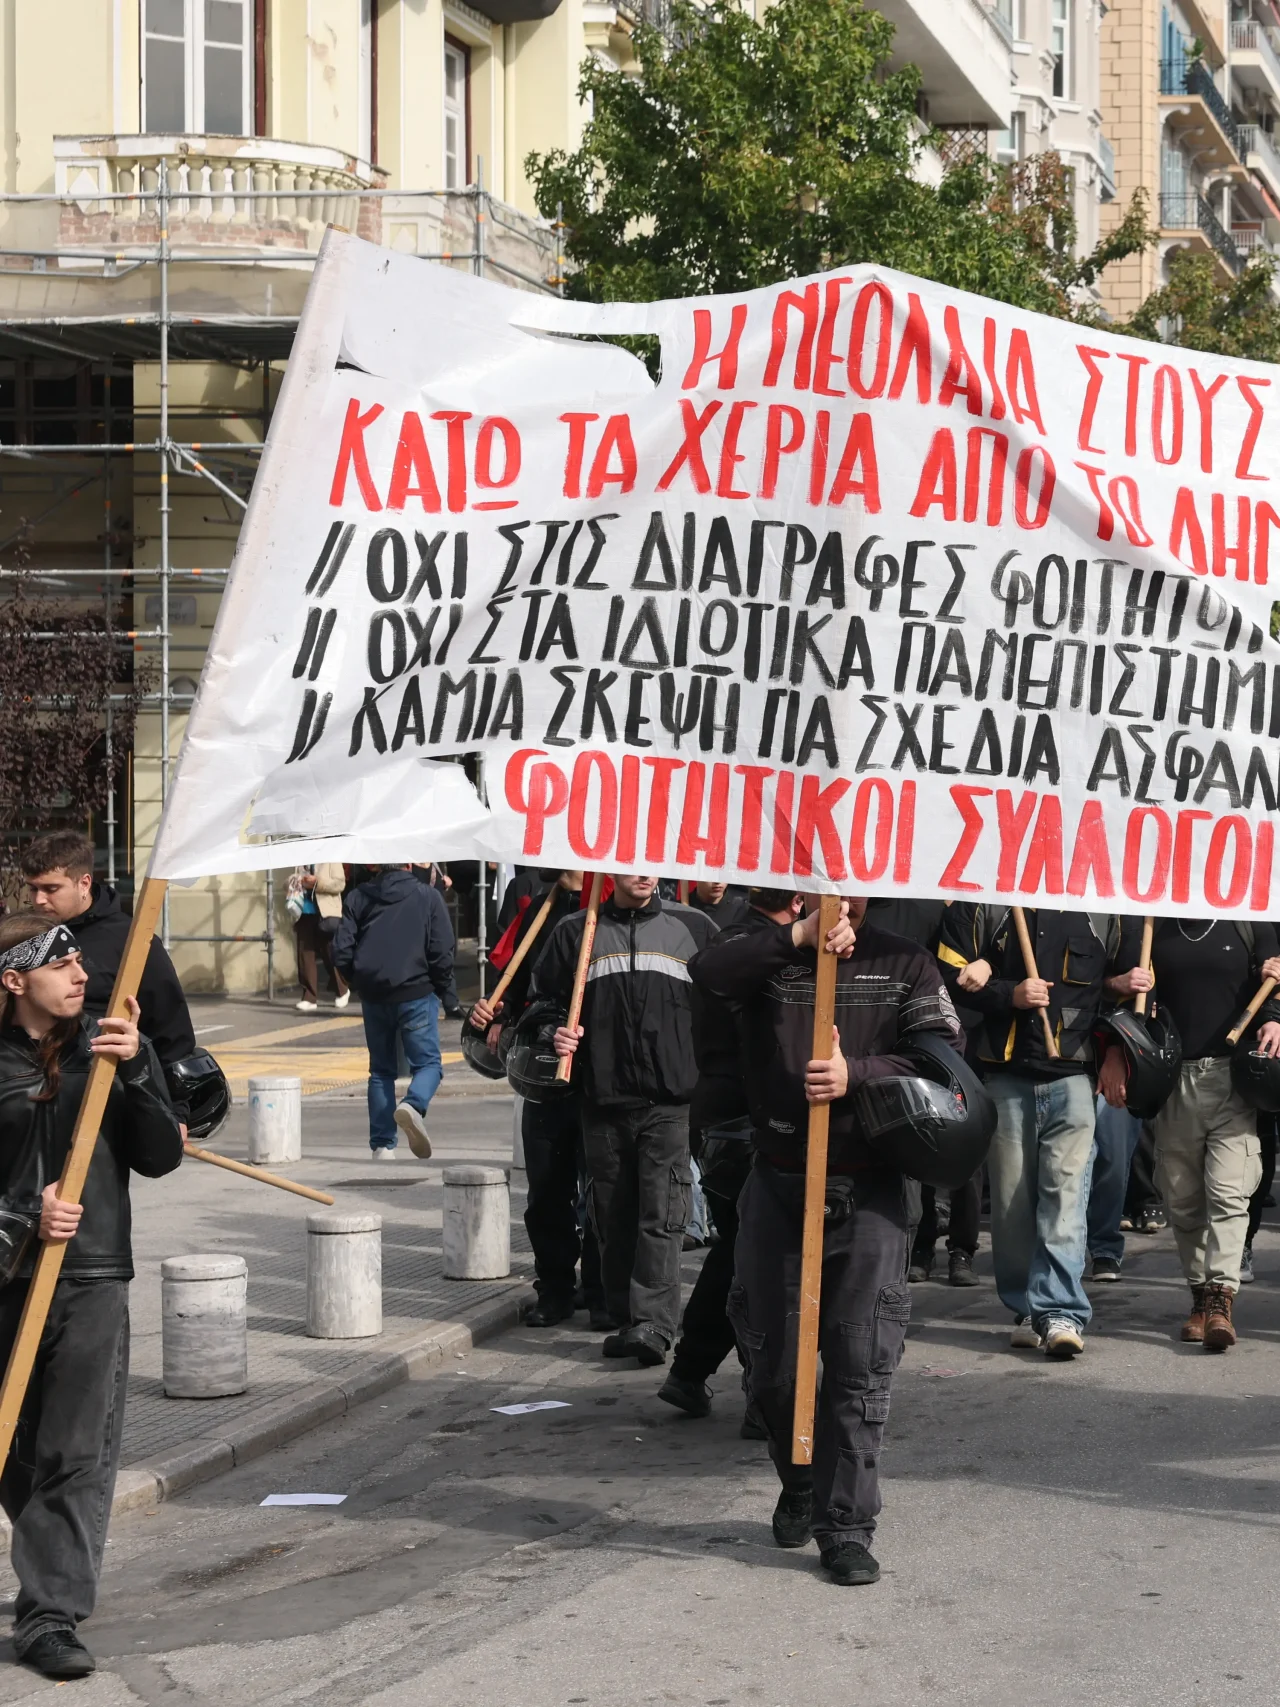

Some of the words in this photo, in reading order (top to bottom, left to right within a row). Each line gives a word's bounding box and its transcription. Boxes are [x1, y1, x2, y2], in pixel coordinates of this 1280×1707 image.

[682, 304, 748, 390] Η
[762, 277, 1047, 436] ΝΕΟΛΑΙΑ
[1076, 345, 1271, 480] ΣΤΟΥΣ
[329, 398, 521, 514] ΚΑΤΩ
[559, 412, 638, 499] ΤΑ
[656, 399, 882, 514] ΧΕΡΙΑ
[909, 426, 1056, 530] ΑΠΟ
[1075, 461, 1154, 548] ΤΟ
[366, 528, 468, 603] ΟΧΙ
[491, 513, 621, 599] ΣΤΙΣ
[631, 510, 979, 624] ΔΙΑΓΡΑΦΕΣ
[367, 604, 462, 685] ΟΧΙ
[467, 588, 579, 665] ΣΤΑ
[601, 594, 875, 691] ΙΔΙΩΤΙΚΑ
[348, 669, 524, 758] ΚΑΜΙΑ
[542, 664, 741, 755] ΣΚΕΨΗ
[757, 688, 840, 769] ΓΙΑ
[854, 694, 1061, 786] ΣΧΕΔΙΑ
[505, 748, 916, 884] ΦΟΙΤΗΤΙΚΟΙ
[938, 784, 1274, 911] ΣΥΛΛΟΓΟΙ
